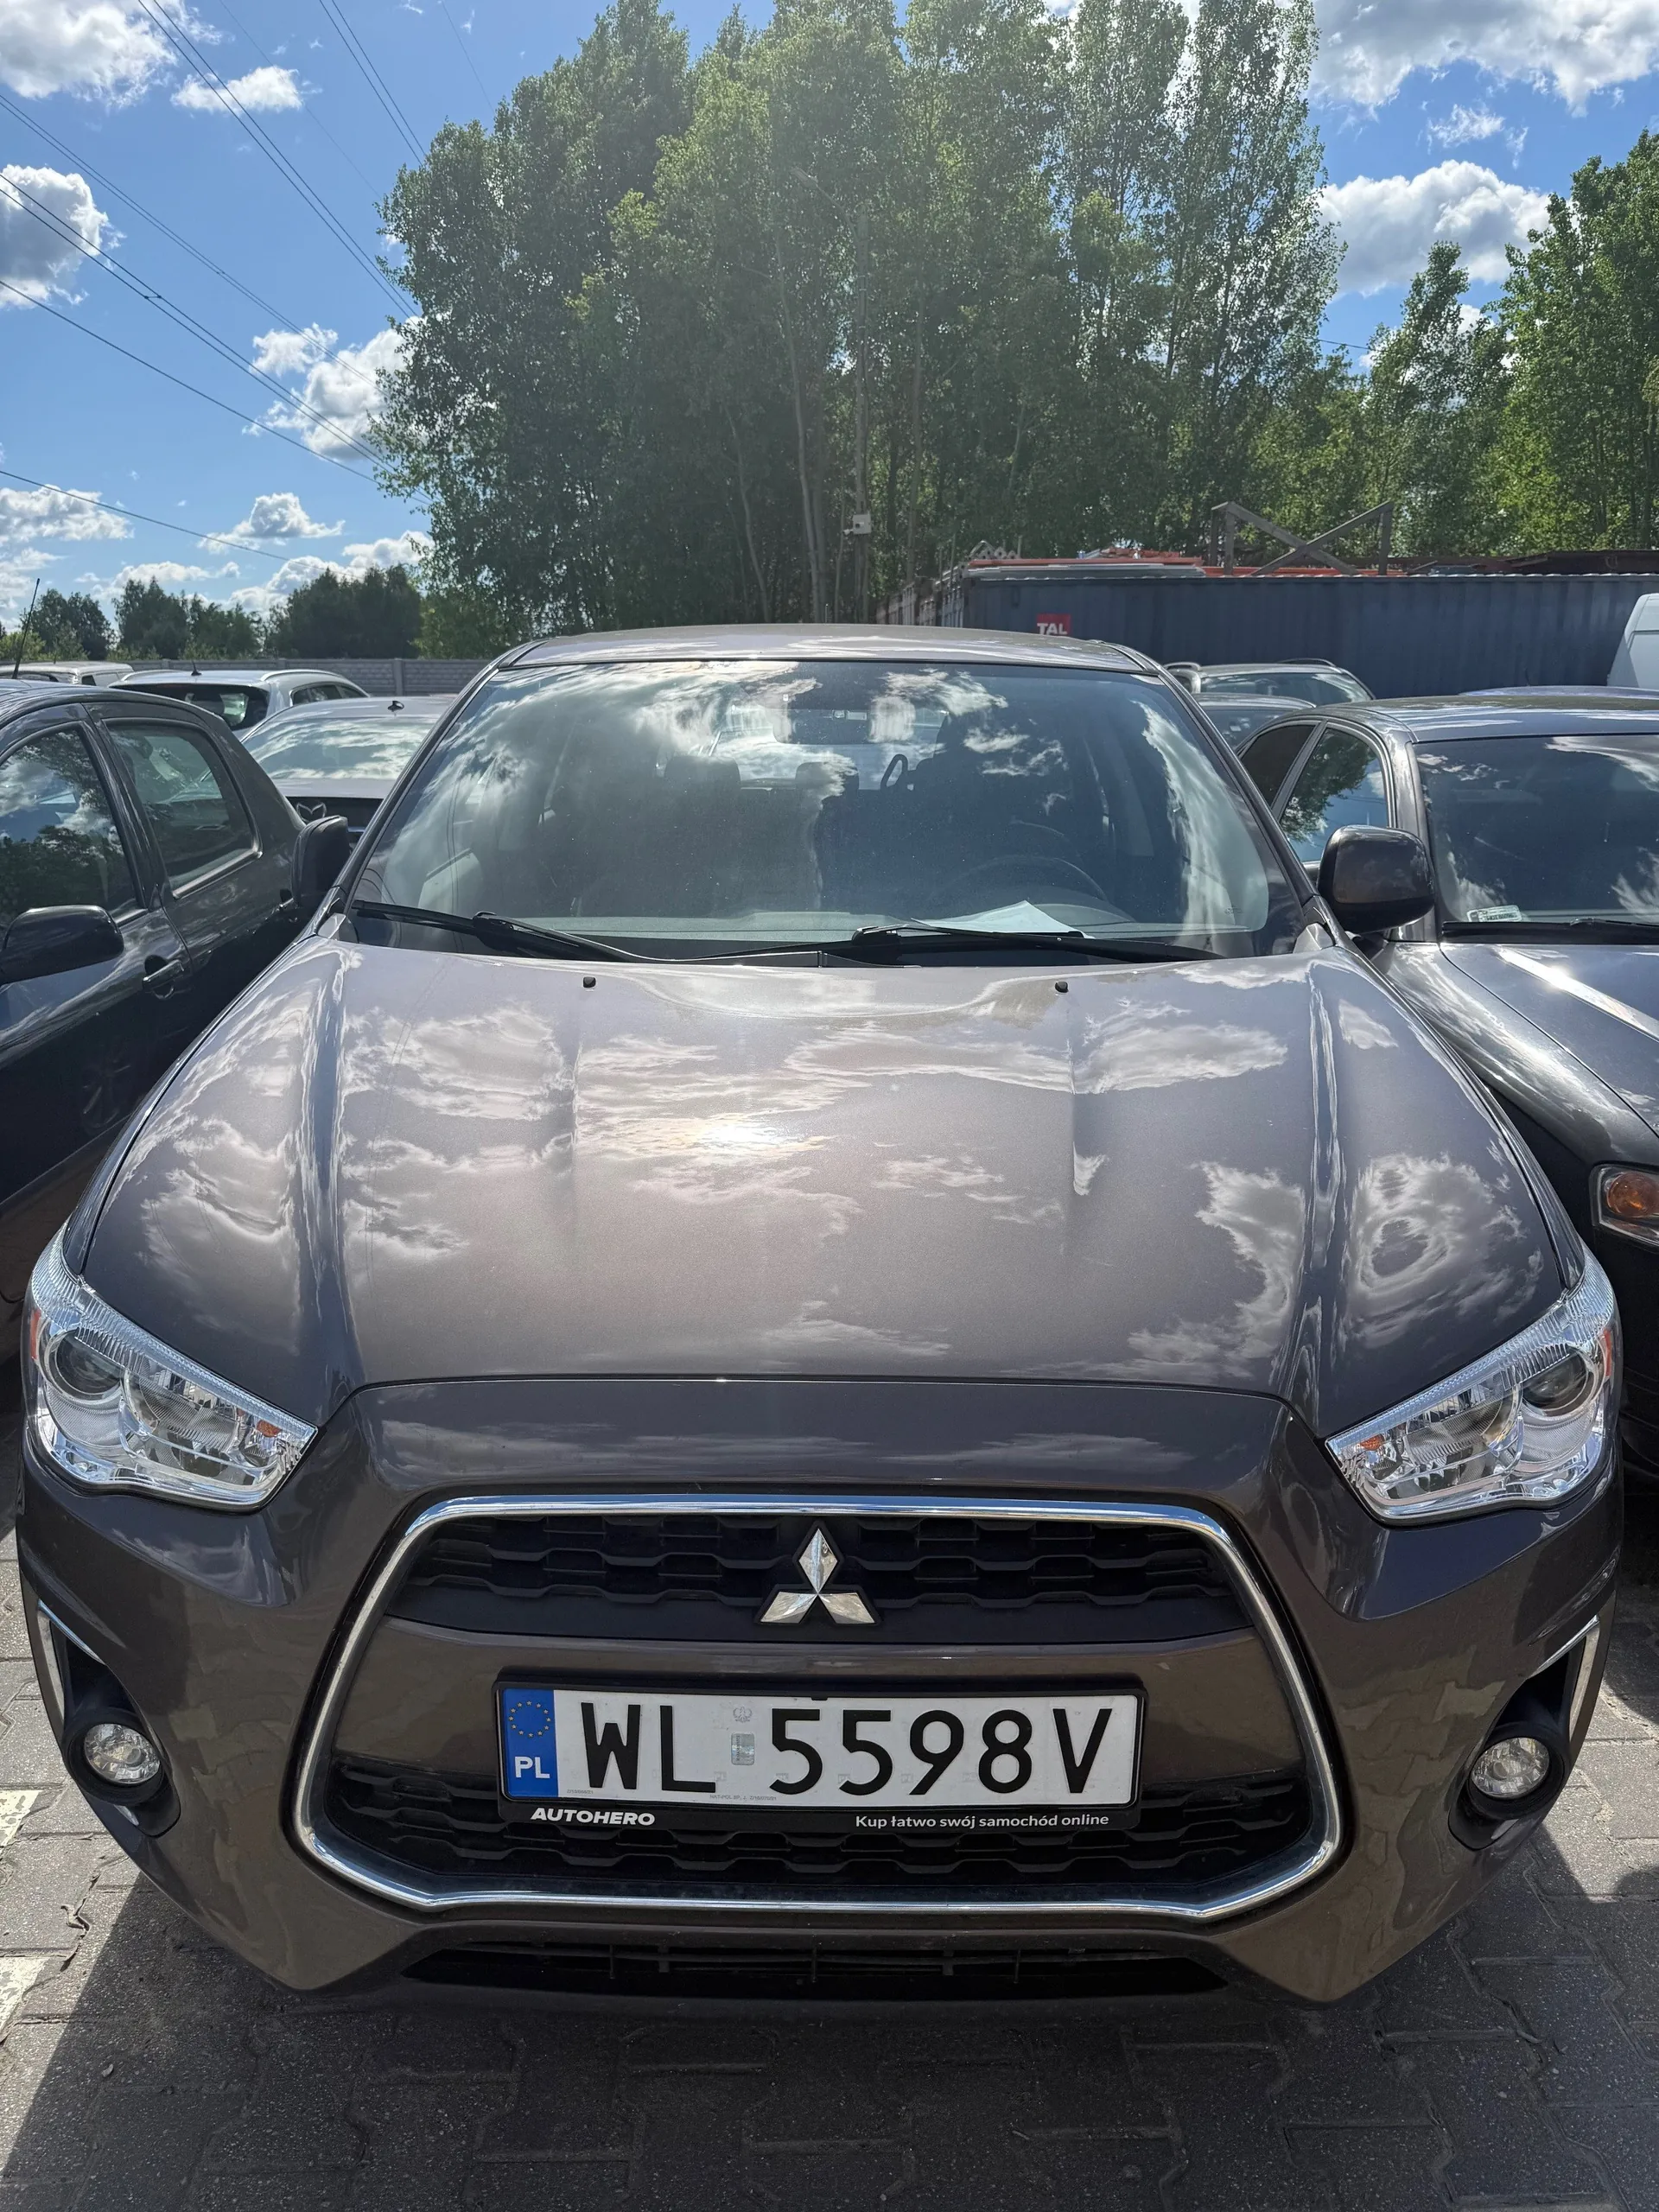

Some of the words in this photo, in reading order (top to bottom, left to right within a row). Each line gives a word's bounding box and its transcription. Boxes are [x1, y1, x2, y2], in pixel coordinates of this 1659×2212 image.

[1037, 623, 1068, 635] TAL
[581, 1702, 716, 1793] WL
[769, 1708, 1113, 1796] 5598V
[514, 1756, 550, 1779] PL
[531, 1808, 655, 1826] AUTOHERO
[855, 1815, 887, 1829] Kup
[891, 1815, 936, 1827] łatwo
[939, 1815, 976, 1829] swój
[978, 1815, 1058, 1827] samochód
[1061, 1814, 1109, 1826] online
